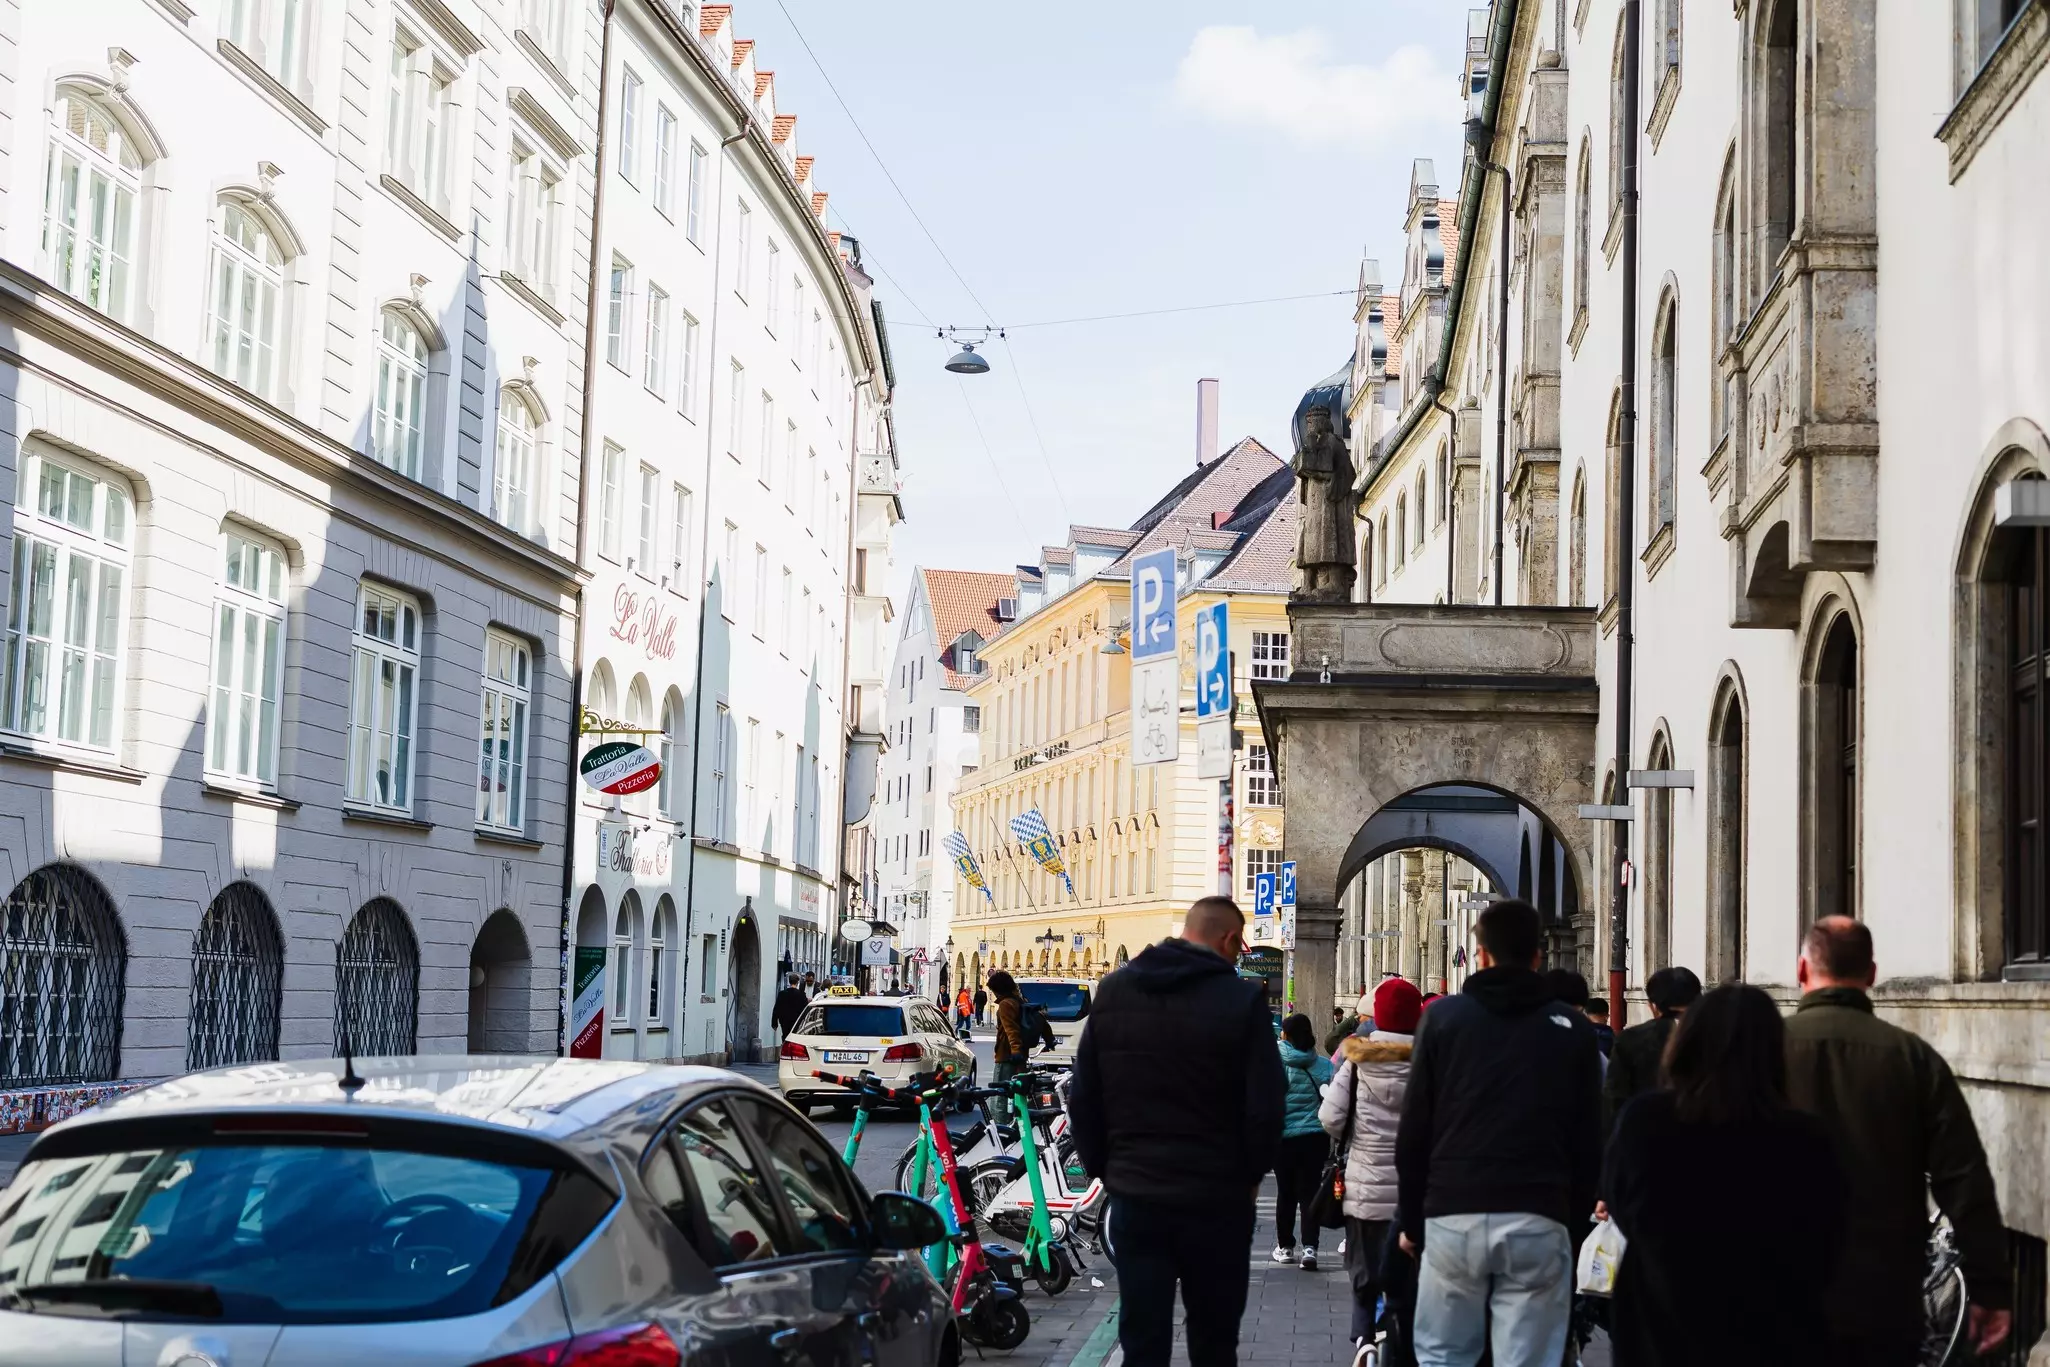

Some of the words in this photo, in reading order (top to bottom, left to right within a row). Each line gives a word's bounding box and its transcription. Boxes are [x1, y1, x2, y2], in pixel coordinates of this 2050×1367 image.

[1138, 565, 1164, 647] P
[609, 582, 639, 645] La
[642, 596, 678, 661] Valle
[1200, 620, 1220, 704] P
[587, 745, 628, 769] Trattoria
[595, 767, 617, 784] La
[615, 753, 649, 774] Valle
[617, 770, 655, 793] Pizzeria
[1257, 878, 1270, 911] P
[1283, 867, 1292, 901] P
[578, 963, 601, 989] Trattoria
[834, 986, 853, 994] TAXI
[574, 1022, 599, 1050] Pizzeria
[853, 1053, 862, 1061] 46
[941, 1150, 954, 1173] voi.
